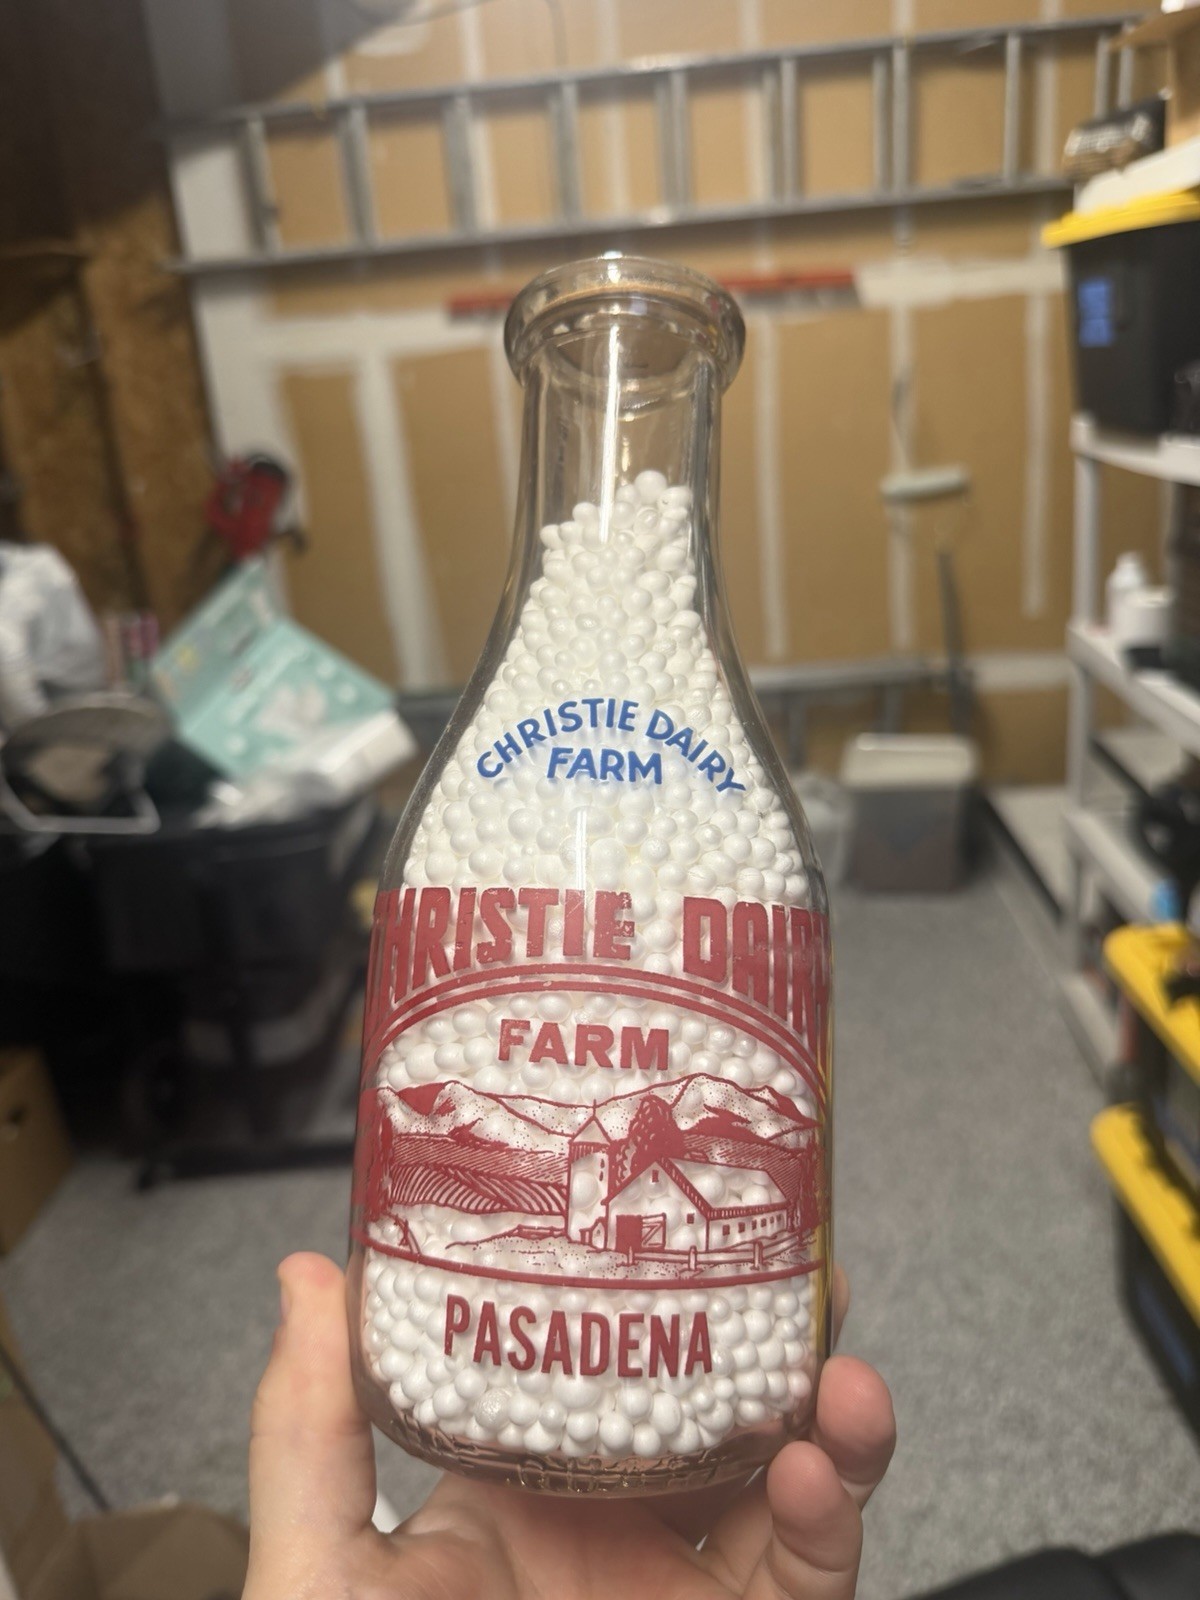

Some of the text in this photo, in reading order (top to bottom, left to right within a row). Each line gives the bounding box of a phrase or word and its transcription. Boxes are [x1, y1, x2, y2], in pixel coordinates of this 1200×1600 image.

[477, 698, 746, 792] CHRISTIE DAIRY
[546, 747, 662, 785] FARM
[498, 1018, 670, 1071] FARM
[444, 1293, 713, 1379] PASADENA
